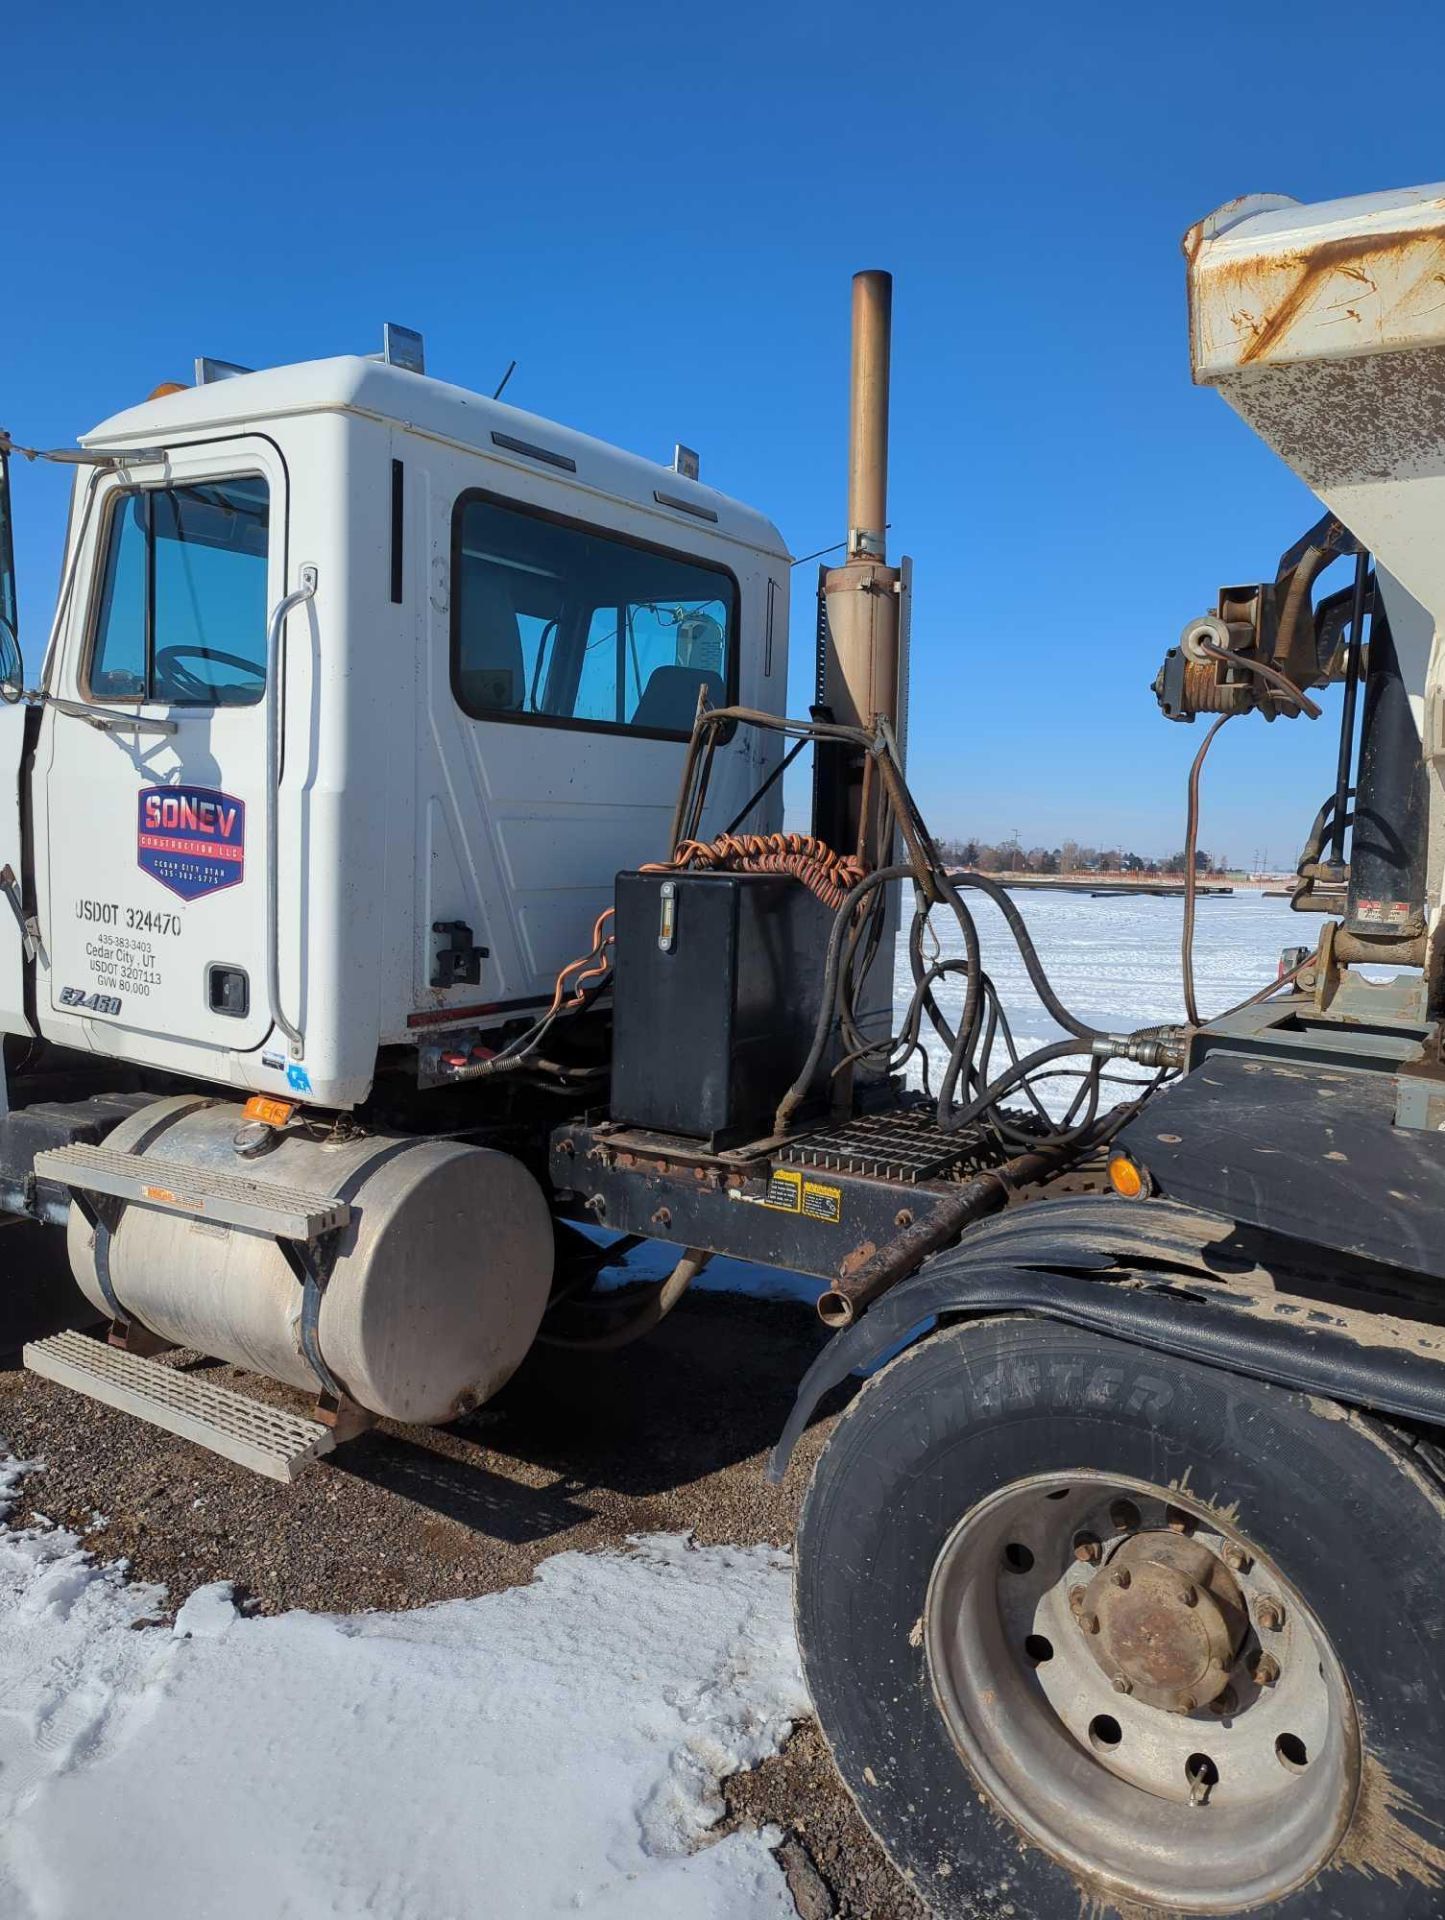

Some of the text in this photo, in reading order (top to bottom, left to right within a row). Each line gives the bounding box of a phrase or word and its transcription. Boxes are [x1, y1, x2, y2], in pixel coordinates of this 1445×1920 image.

[145, 796, 236, 837] SONEV
[141, 837, 238, 857] CONSTRUCTION LLC
[181, 862, 199, 872] CITY
[204, 867, 225, 877] UTAH
[75, 899, 182, 937] USDOT 324470
[85, 942, 114, 960] Cedar
[116, 948, 135, 968] City
[142, 954, 156, 969] UT
[89, 959, 162, 985] USDOT 3207113
[97, 974, 117, 989] GVW
